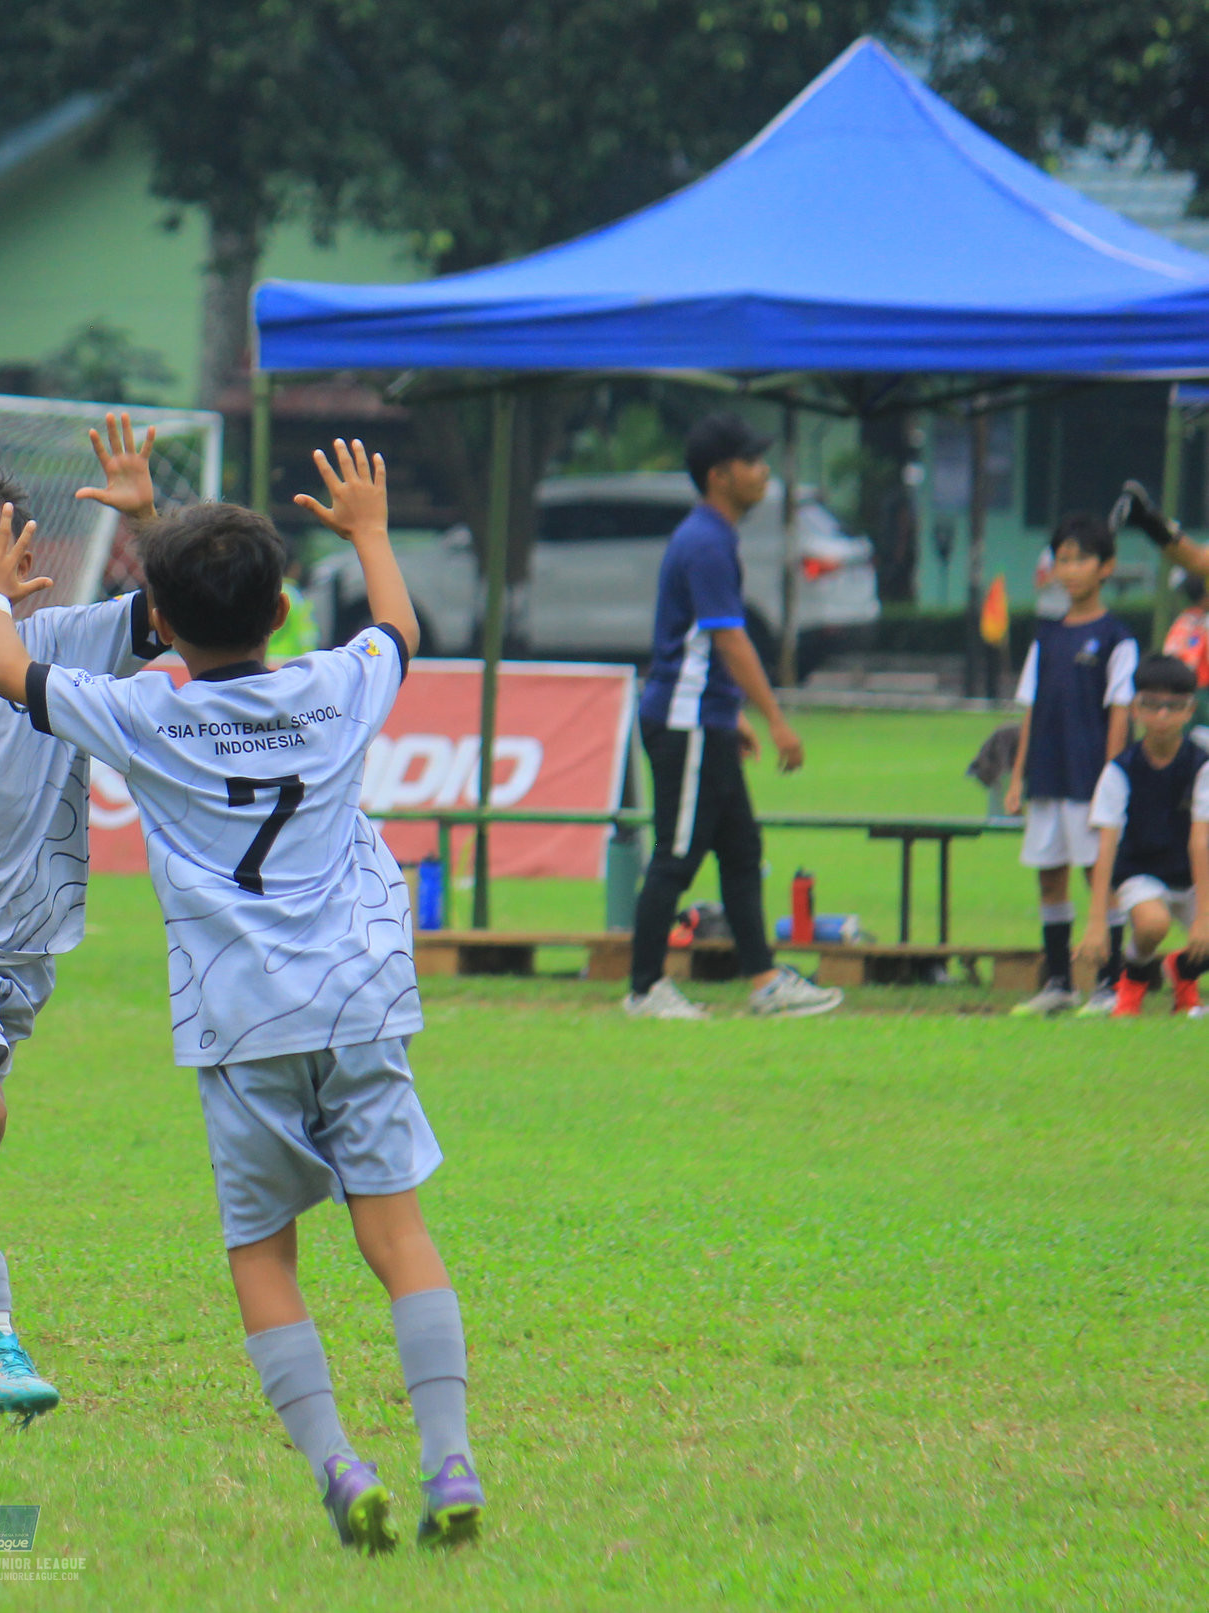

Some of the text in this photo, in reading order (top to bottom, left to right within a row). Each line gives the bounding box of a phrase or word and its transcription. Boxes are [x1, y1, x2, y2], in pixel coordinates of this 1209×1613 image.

[157, 704, 342, 739] ASIA FOOTBALL SCHOOL
[215, 733, 306, 755] INDONESIA
[225, 773, 305, 896] 7
